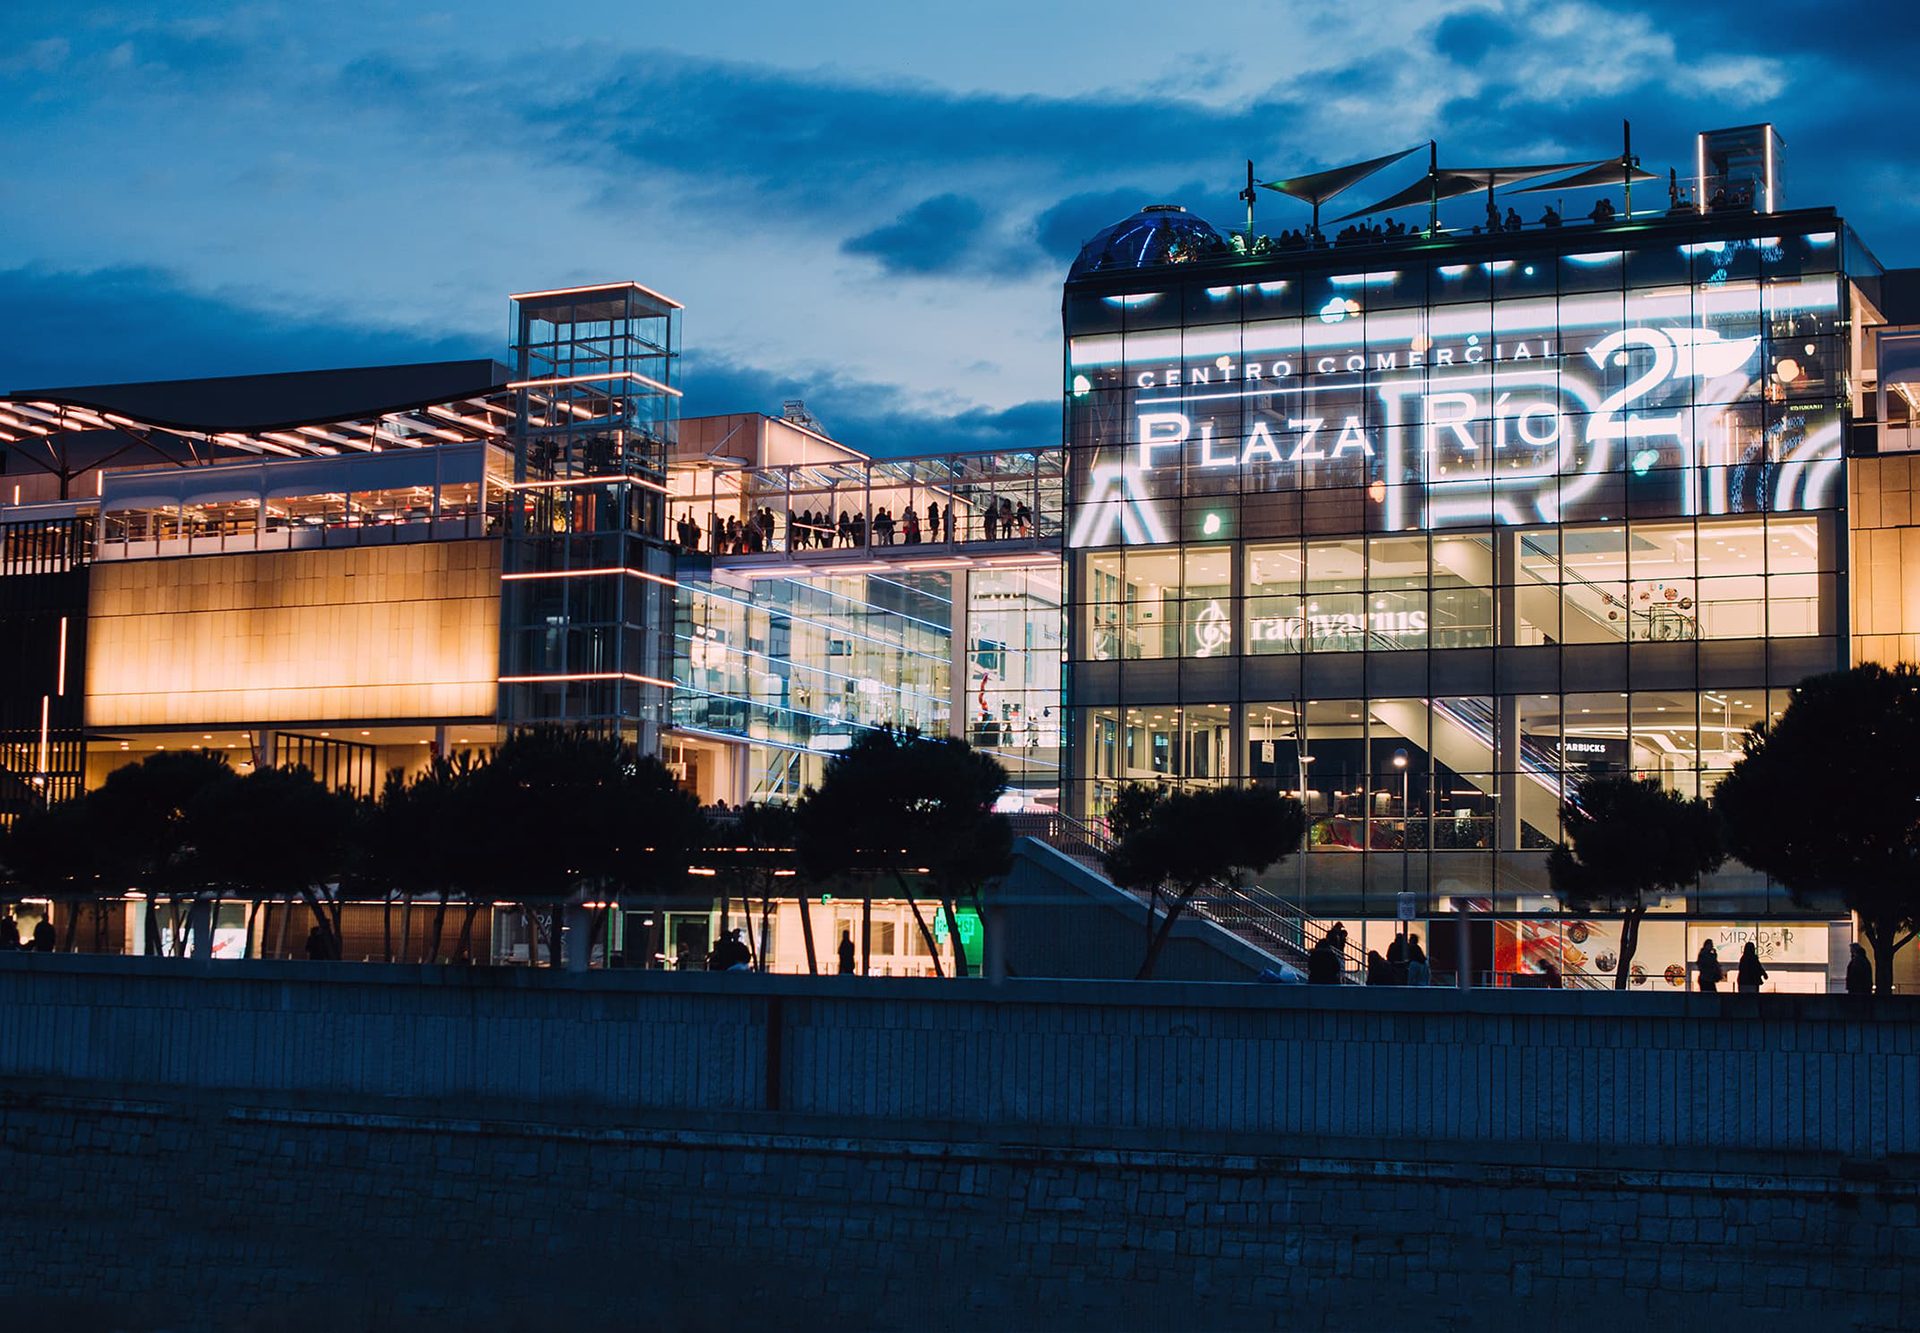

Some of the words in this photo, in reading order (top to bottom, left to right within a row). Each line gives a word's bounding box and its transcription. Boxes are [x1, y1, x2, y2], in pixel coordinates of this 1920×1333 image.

[1137, 360, 1292, 389] CENTRO
[1317, 340, 1559, 374] COMERCIAL
[1137, 411, 1376, 471] PLAZA
